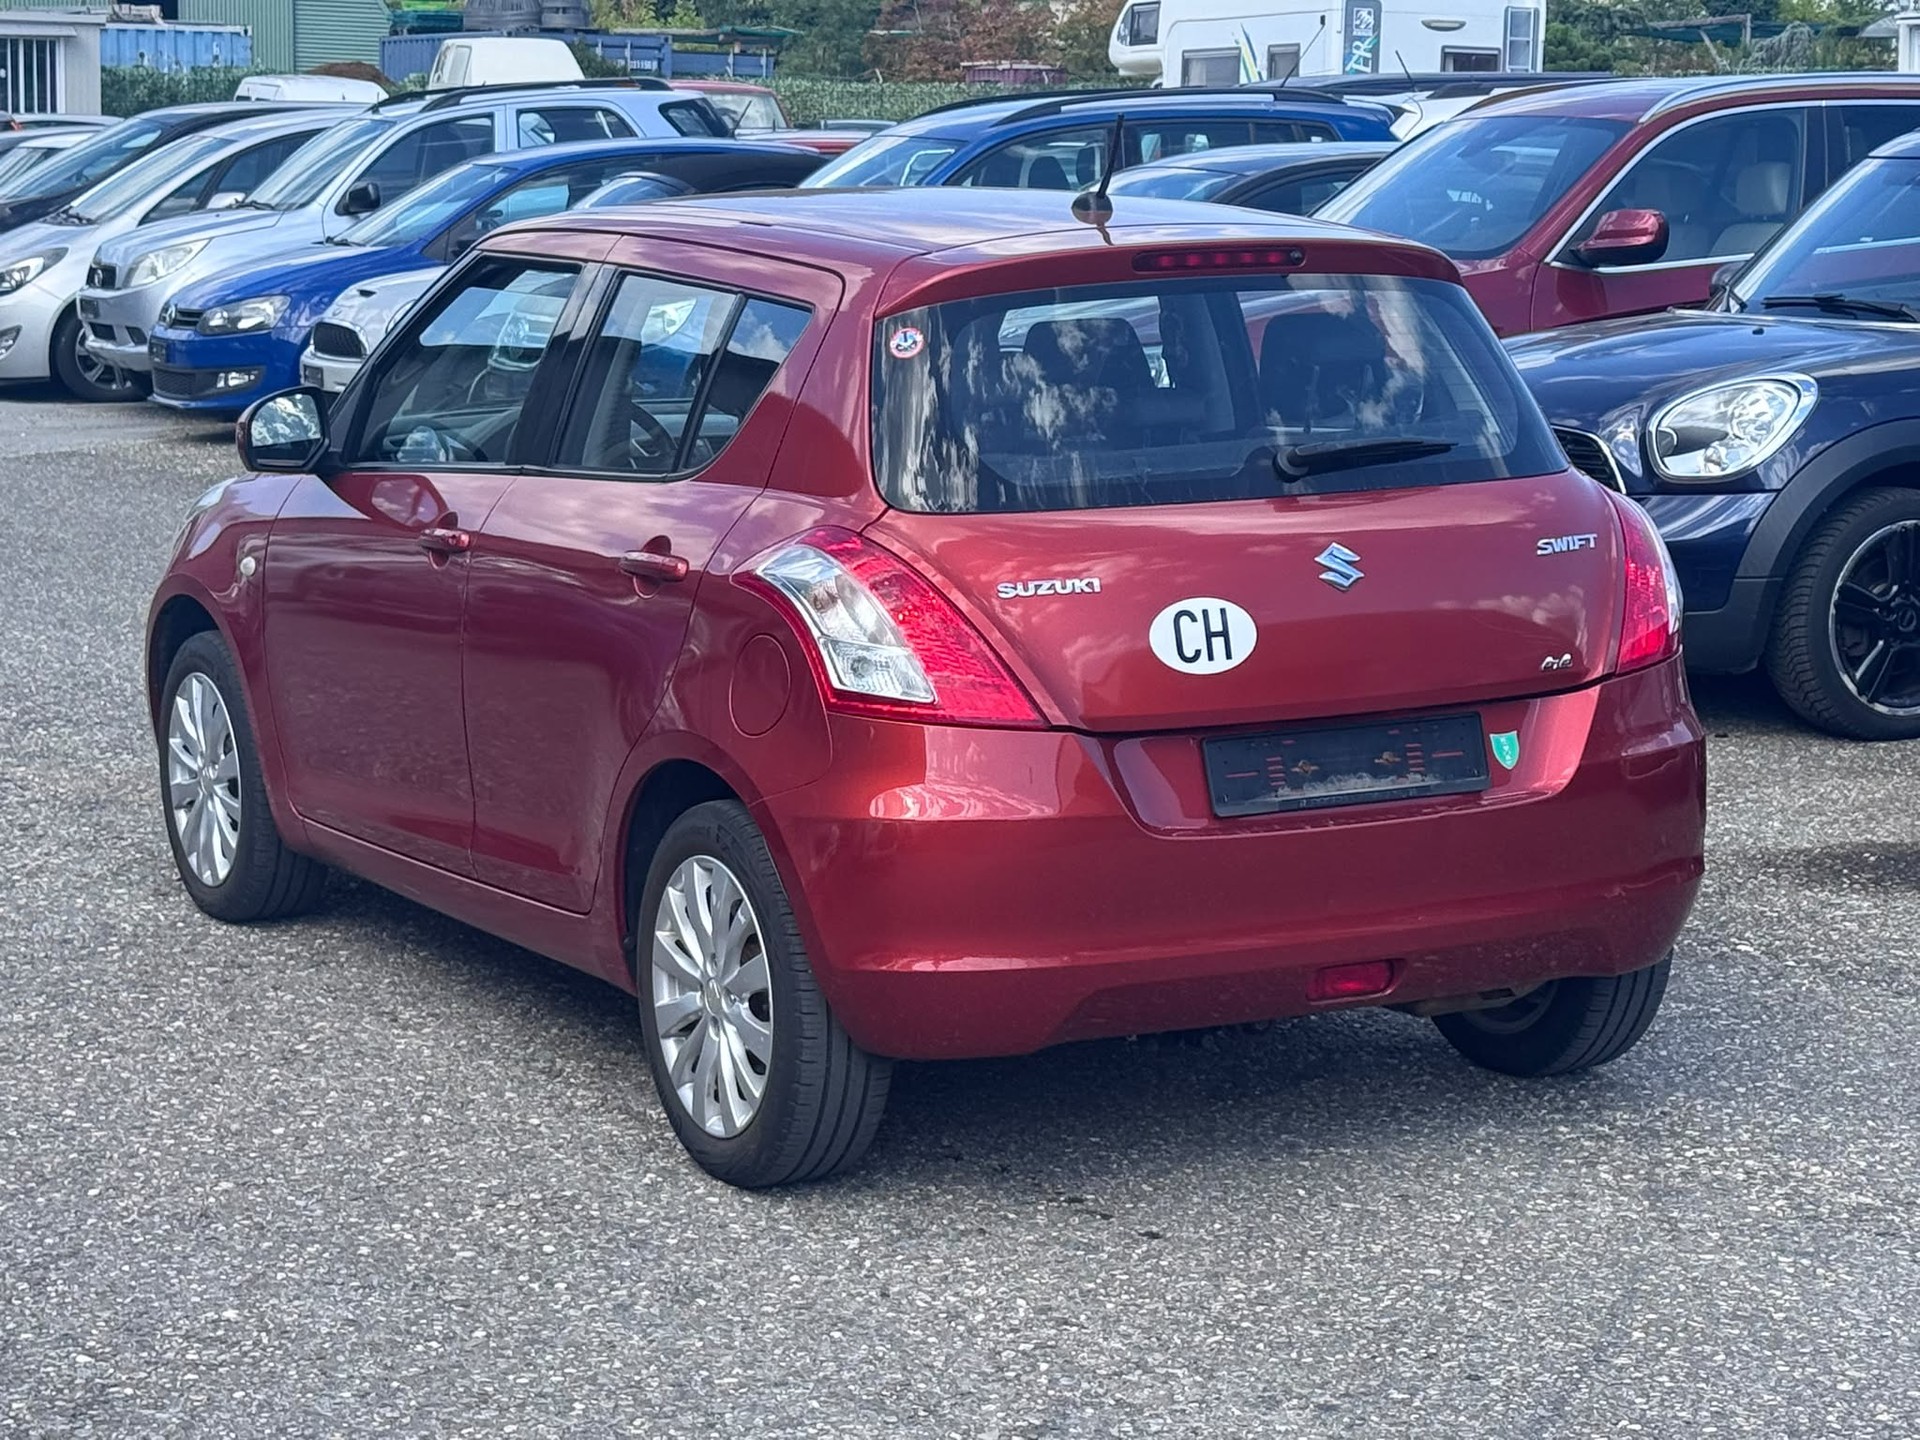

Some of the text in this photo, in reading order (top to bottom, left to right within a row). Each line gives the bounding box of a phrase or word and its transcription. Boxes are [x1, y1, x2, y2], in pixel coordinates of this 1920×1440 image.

[1537, 533, 1598, 555] SWIFT
[997, 577, 1101, 599] SUZUKI
[1173, 607, 1233, 664] CH
